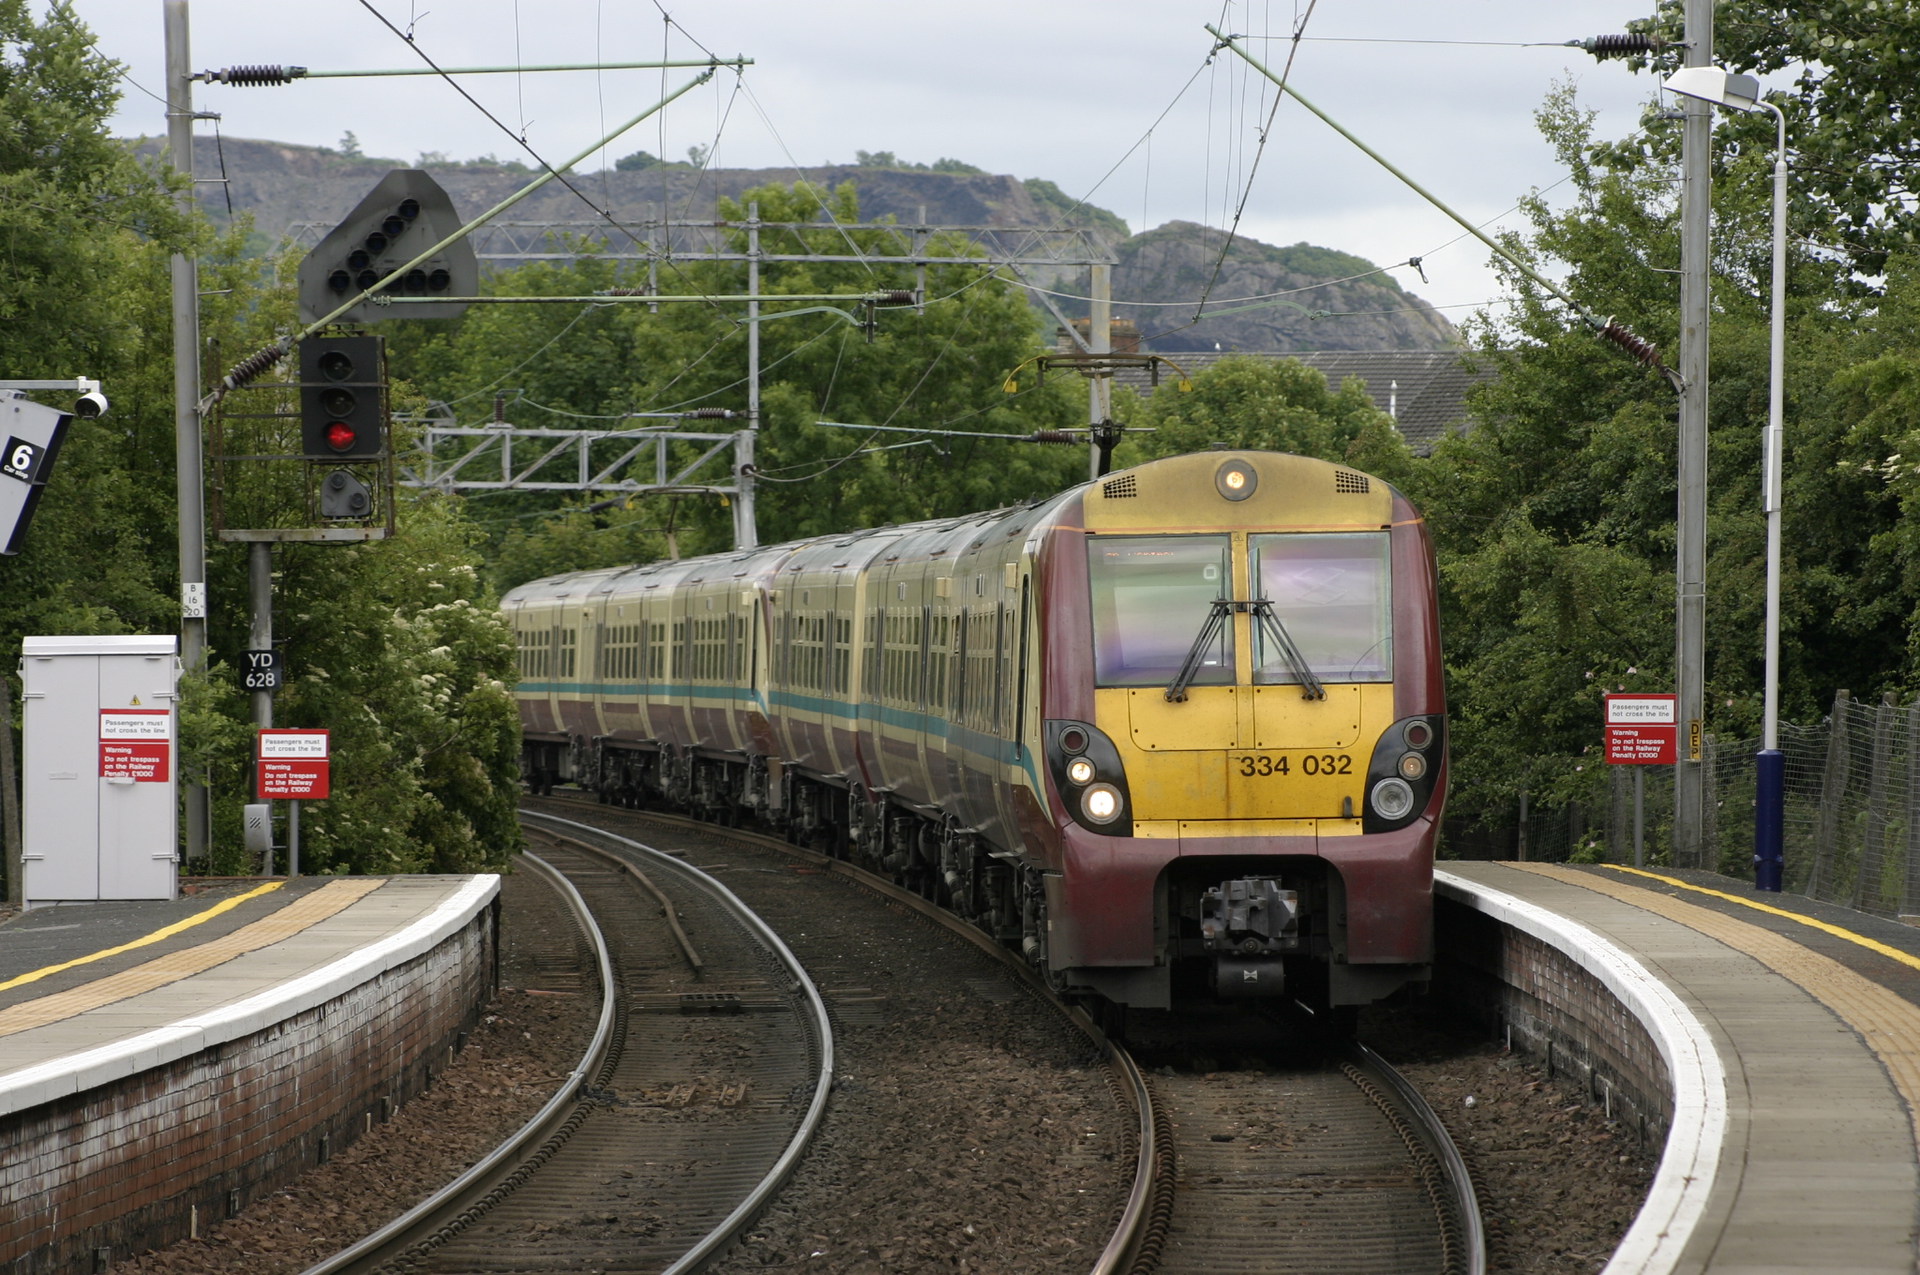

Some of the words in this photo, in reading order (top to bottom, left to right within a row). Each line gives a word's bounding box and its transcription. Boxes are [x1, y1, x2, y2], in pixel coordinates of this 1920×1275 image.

[12, 444, 33, 470] 6
[190, 584, 196, 592] B
[248, 653, 273, 668] YD
[246, 672, 276, 688] 628
[1240, 756, 1290, 776] 334
[1302, 754, 1352, 776] 032
